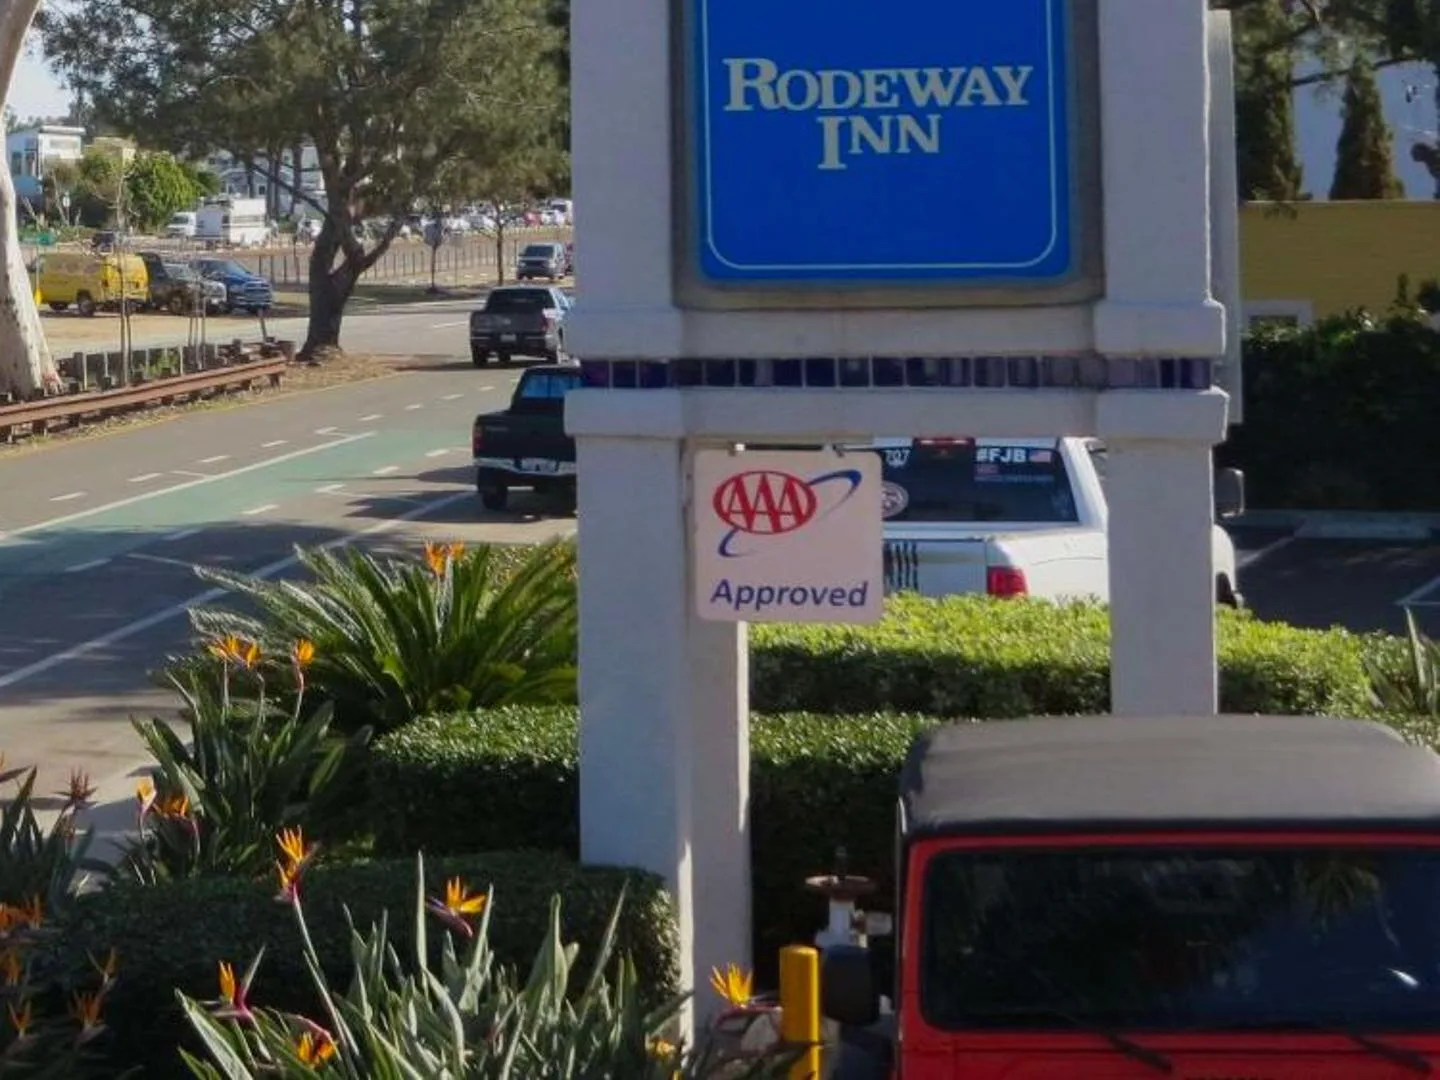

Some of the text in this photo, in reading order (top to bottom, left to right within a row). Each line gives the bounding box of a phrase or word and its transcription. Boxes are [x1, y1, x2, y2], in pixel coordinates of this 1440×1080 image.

[722, 58, 1034, 112] RODEWAY
[817, 114, 941, 170] INN
[975, 448, 1027, 464] #FJB
[723, 472, 811, 534] AAA
[710, 578, 869, 611] Approved
